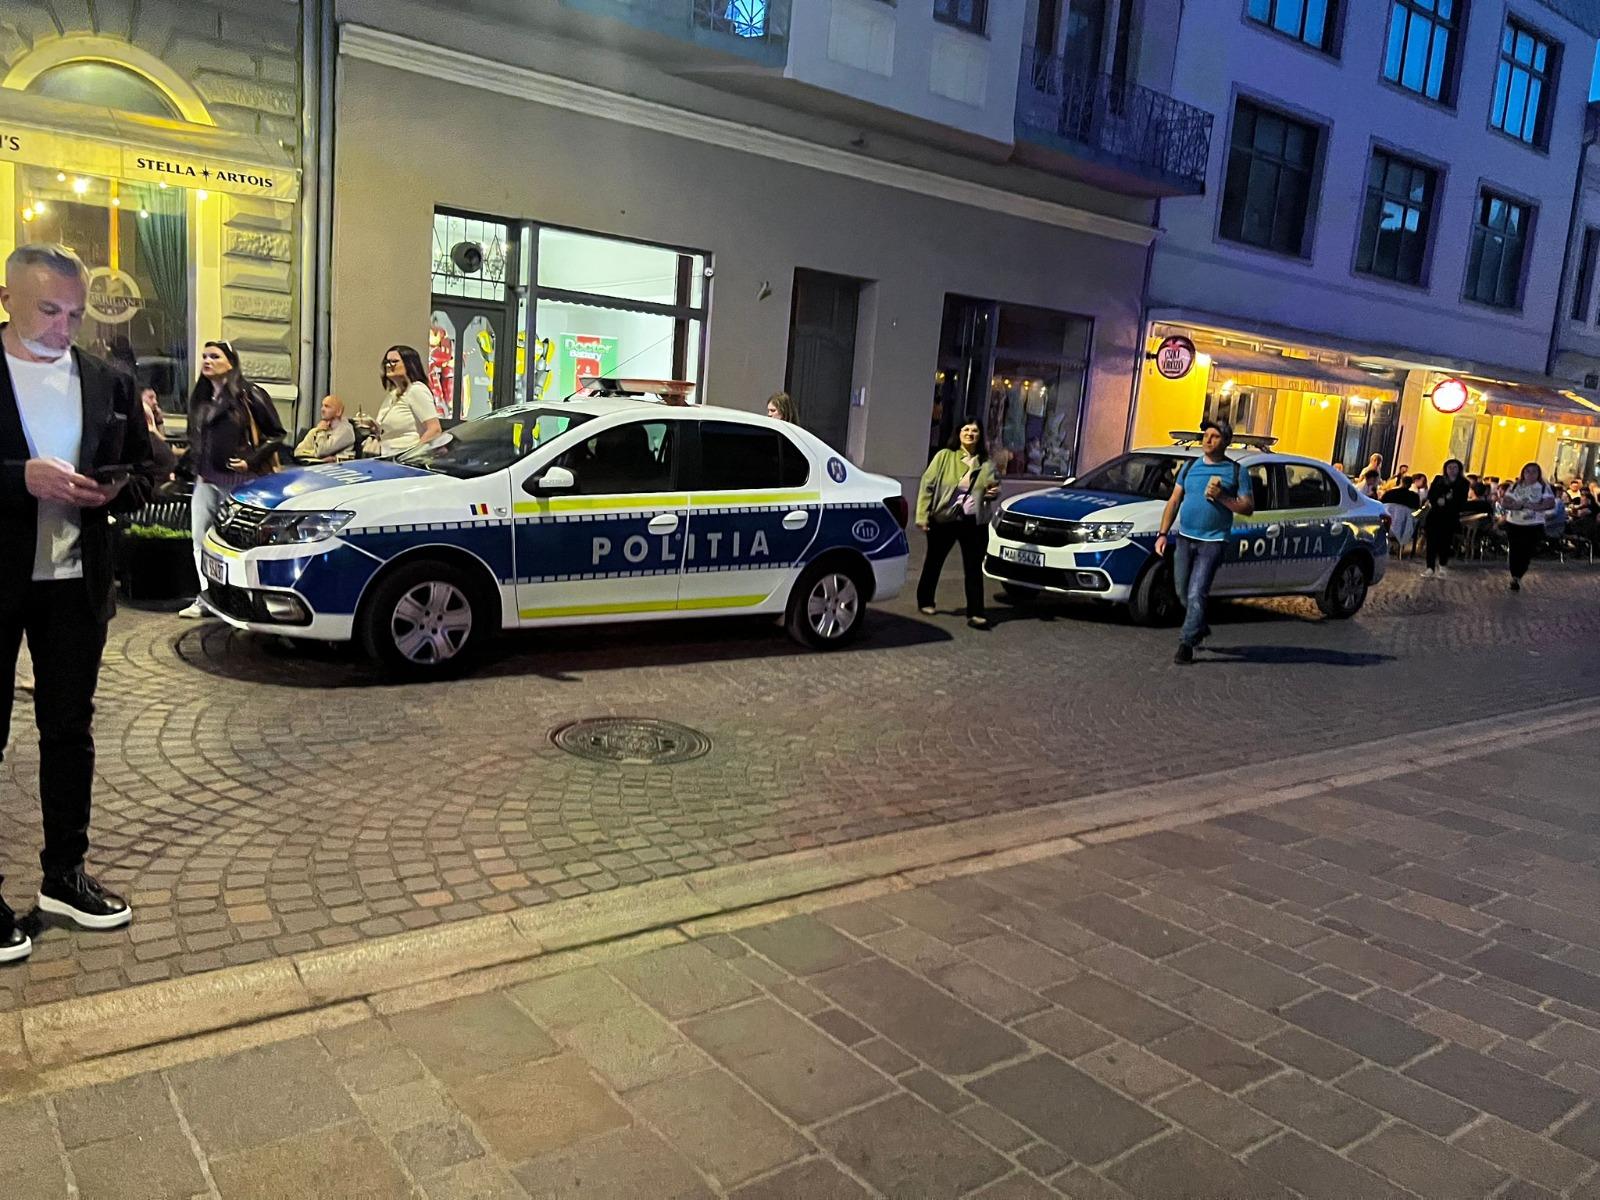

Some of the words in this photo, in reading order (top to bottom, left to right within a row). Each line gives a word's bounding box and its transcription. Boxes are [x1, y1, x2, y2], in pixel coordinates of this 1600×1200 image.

[0, 135, 20, 151] 'S
[137, 157, 196, 177] STELLA
[216, 171, 273, 188] ARTOIS
[592, 531, 769, 565] POLITIA
[1239, 537, 1323, 559] POLITIA
